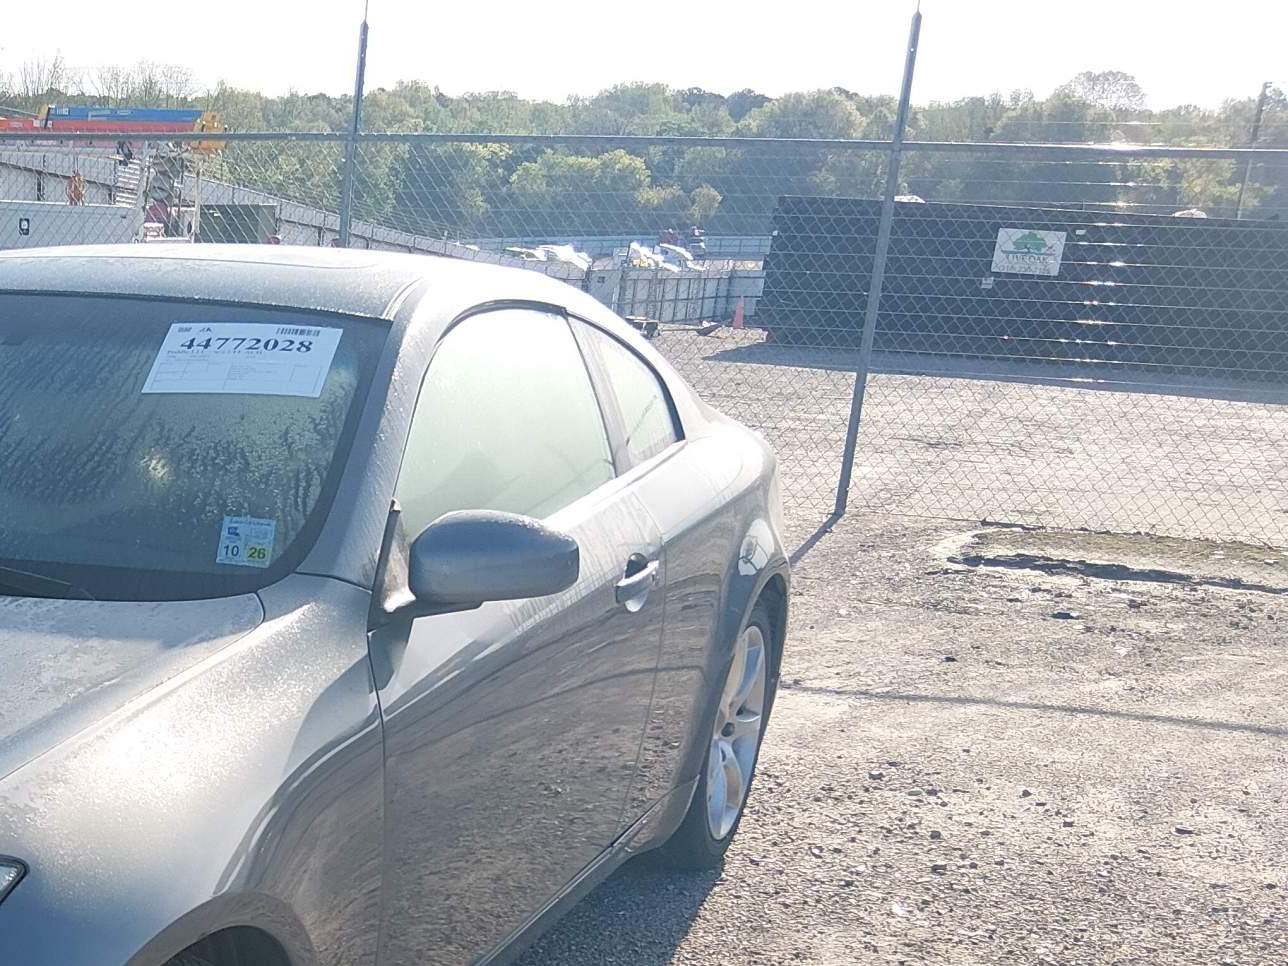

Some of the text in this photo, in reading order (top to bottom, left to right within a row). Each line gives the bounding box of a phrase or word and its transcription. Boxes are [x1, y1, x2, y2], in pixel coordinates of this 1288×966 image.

[180, 337, 313, 353] 44772028
[223, 544, 266, 559] 10 26
